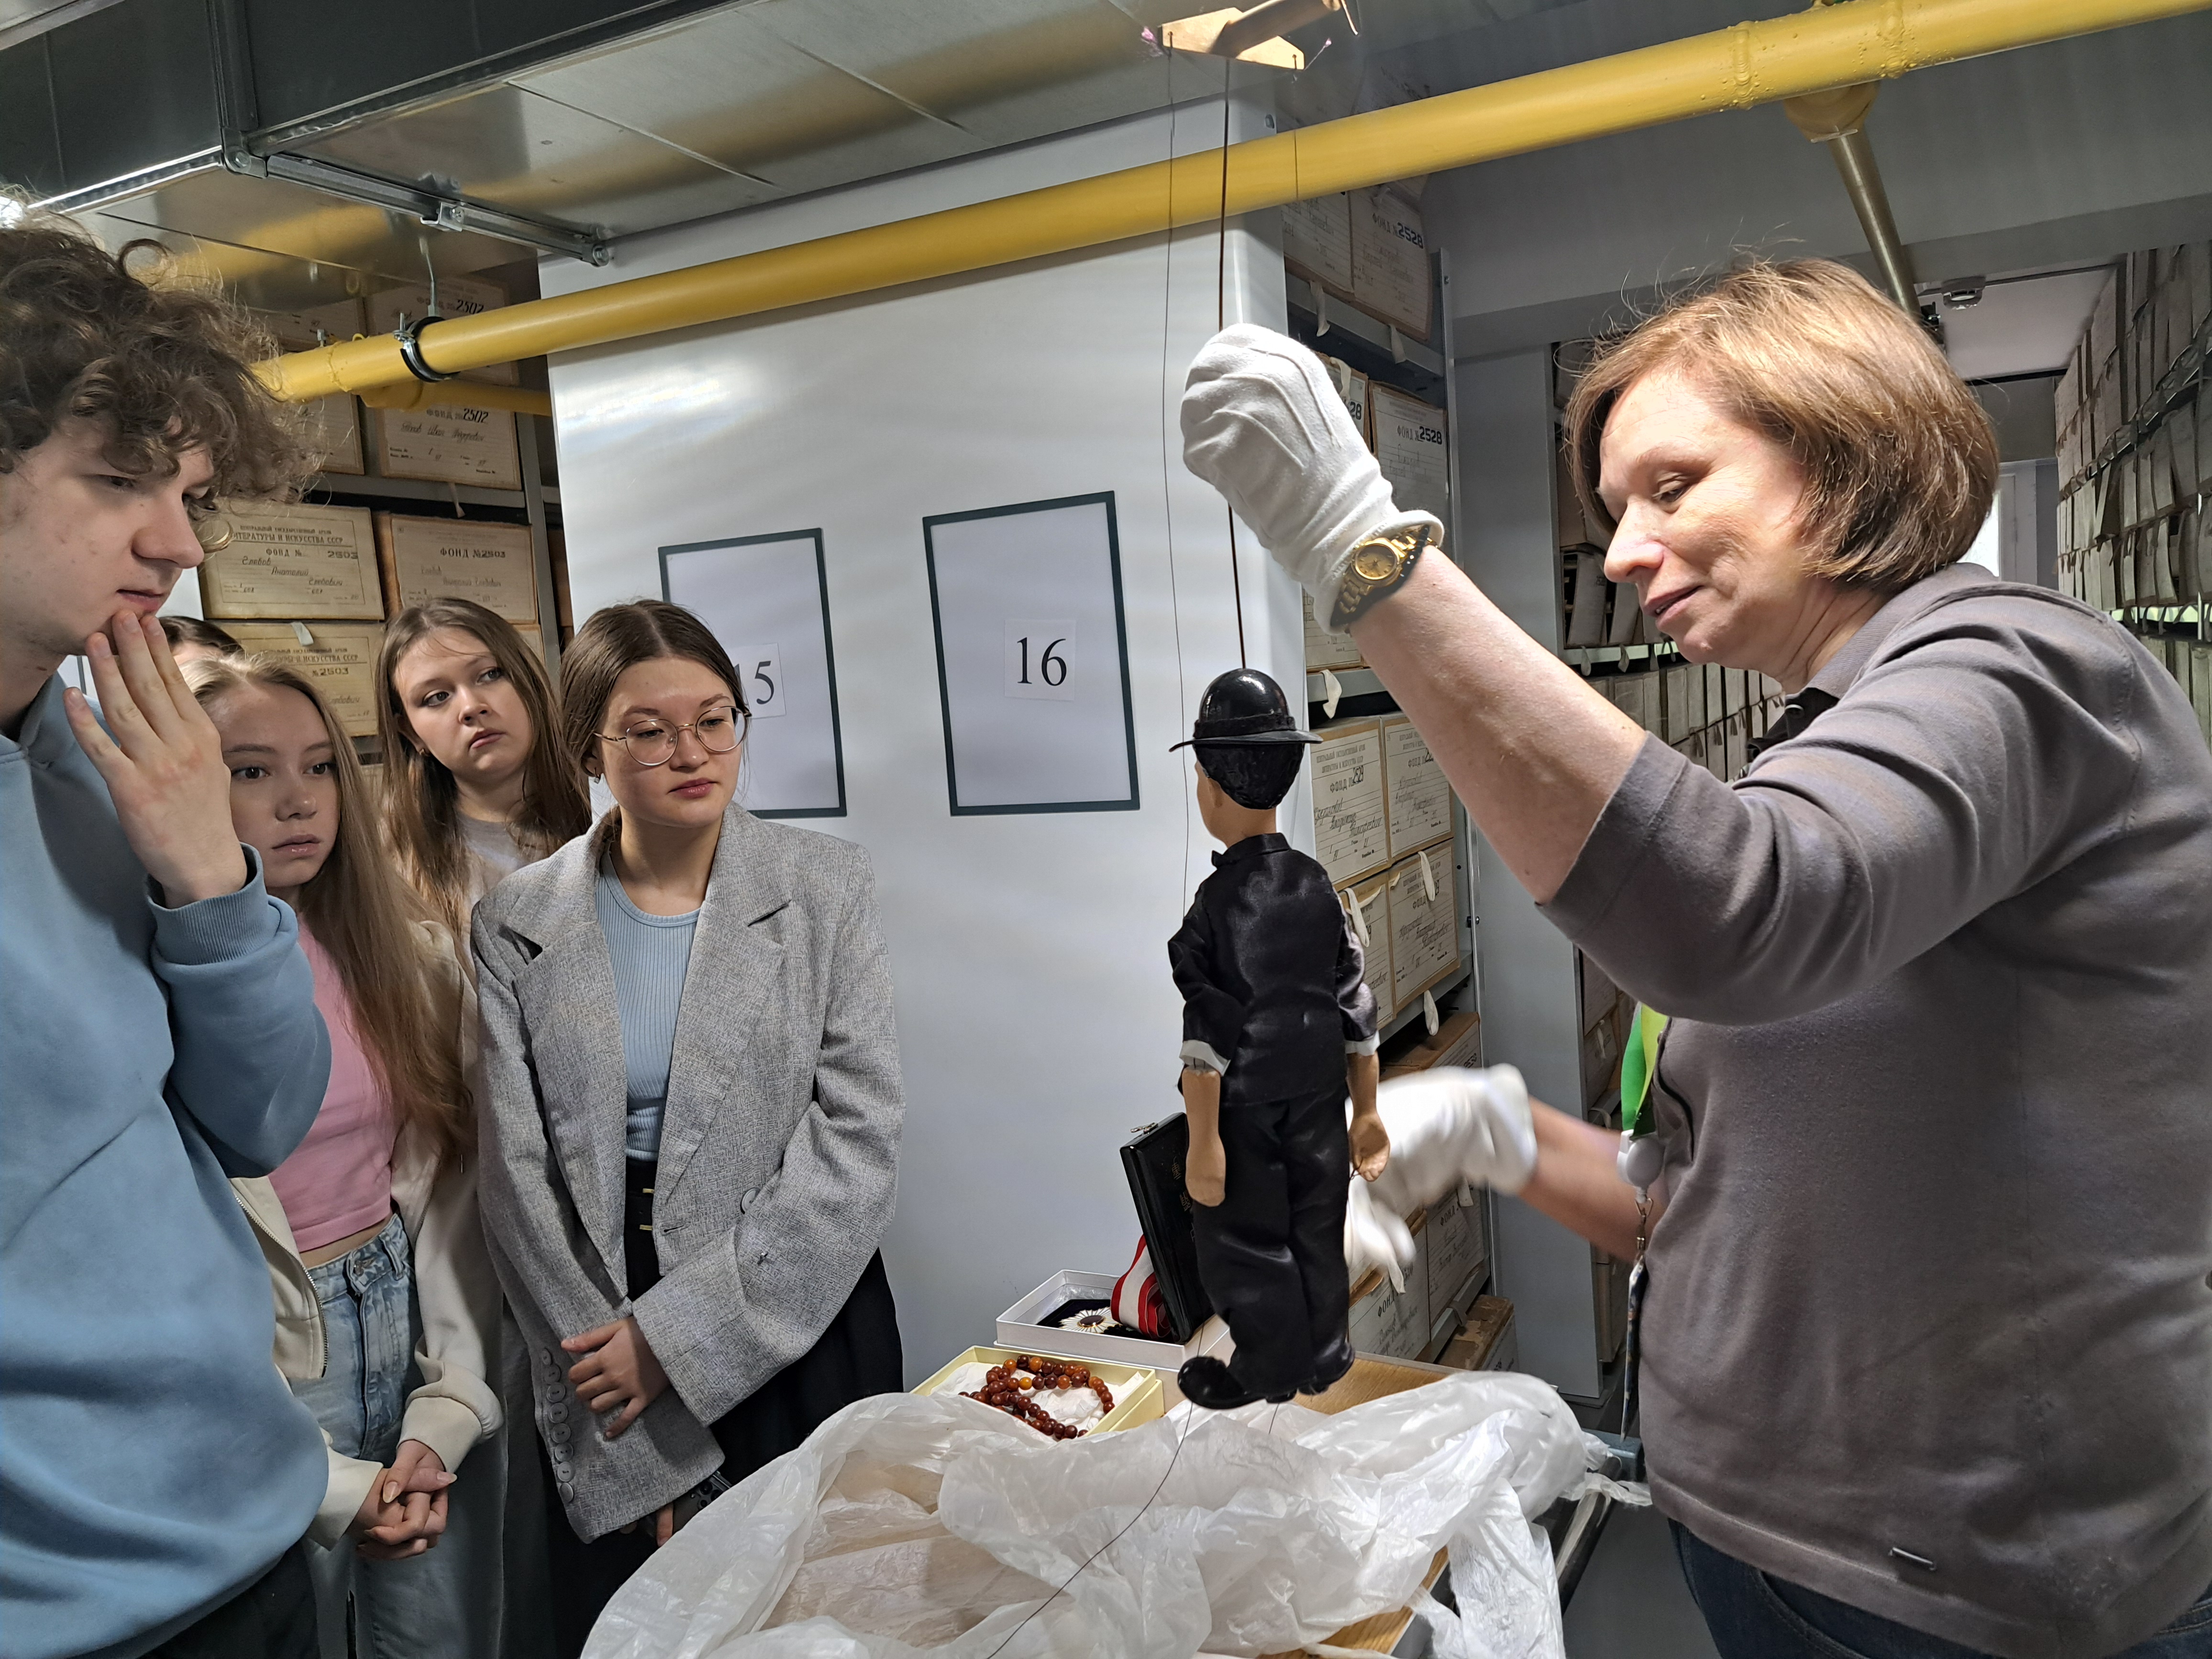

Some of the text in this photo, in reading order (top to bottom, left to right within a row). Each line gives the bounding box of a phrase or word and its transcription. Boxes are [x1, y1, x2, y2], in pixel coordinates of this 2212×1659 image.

[1372, 213, 1391, 234] ФОНД
[1397, 425, 1414, 441] ФОНД
[233, 532, 275, 541] ИТЕРАТУРЫ
[286, 535, 324, 543] ИСКУССТВА
[266, 548, 289, 557] ФОНД
[328, 551, 359, 559] 2503
[440, 547, 469, 558] ФОНД
[1017, 637, 1066, 686] 16
[1330, 778, 1348, 794] ФОНД
[1378, 1290, 1395, 1317] ФОНД
